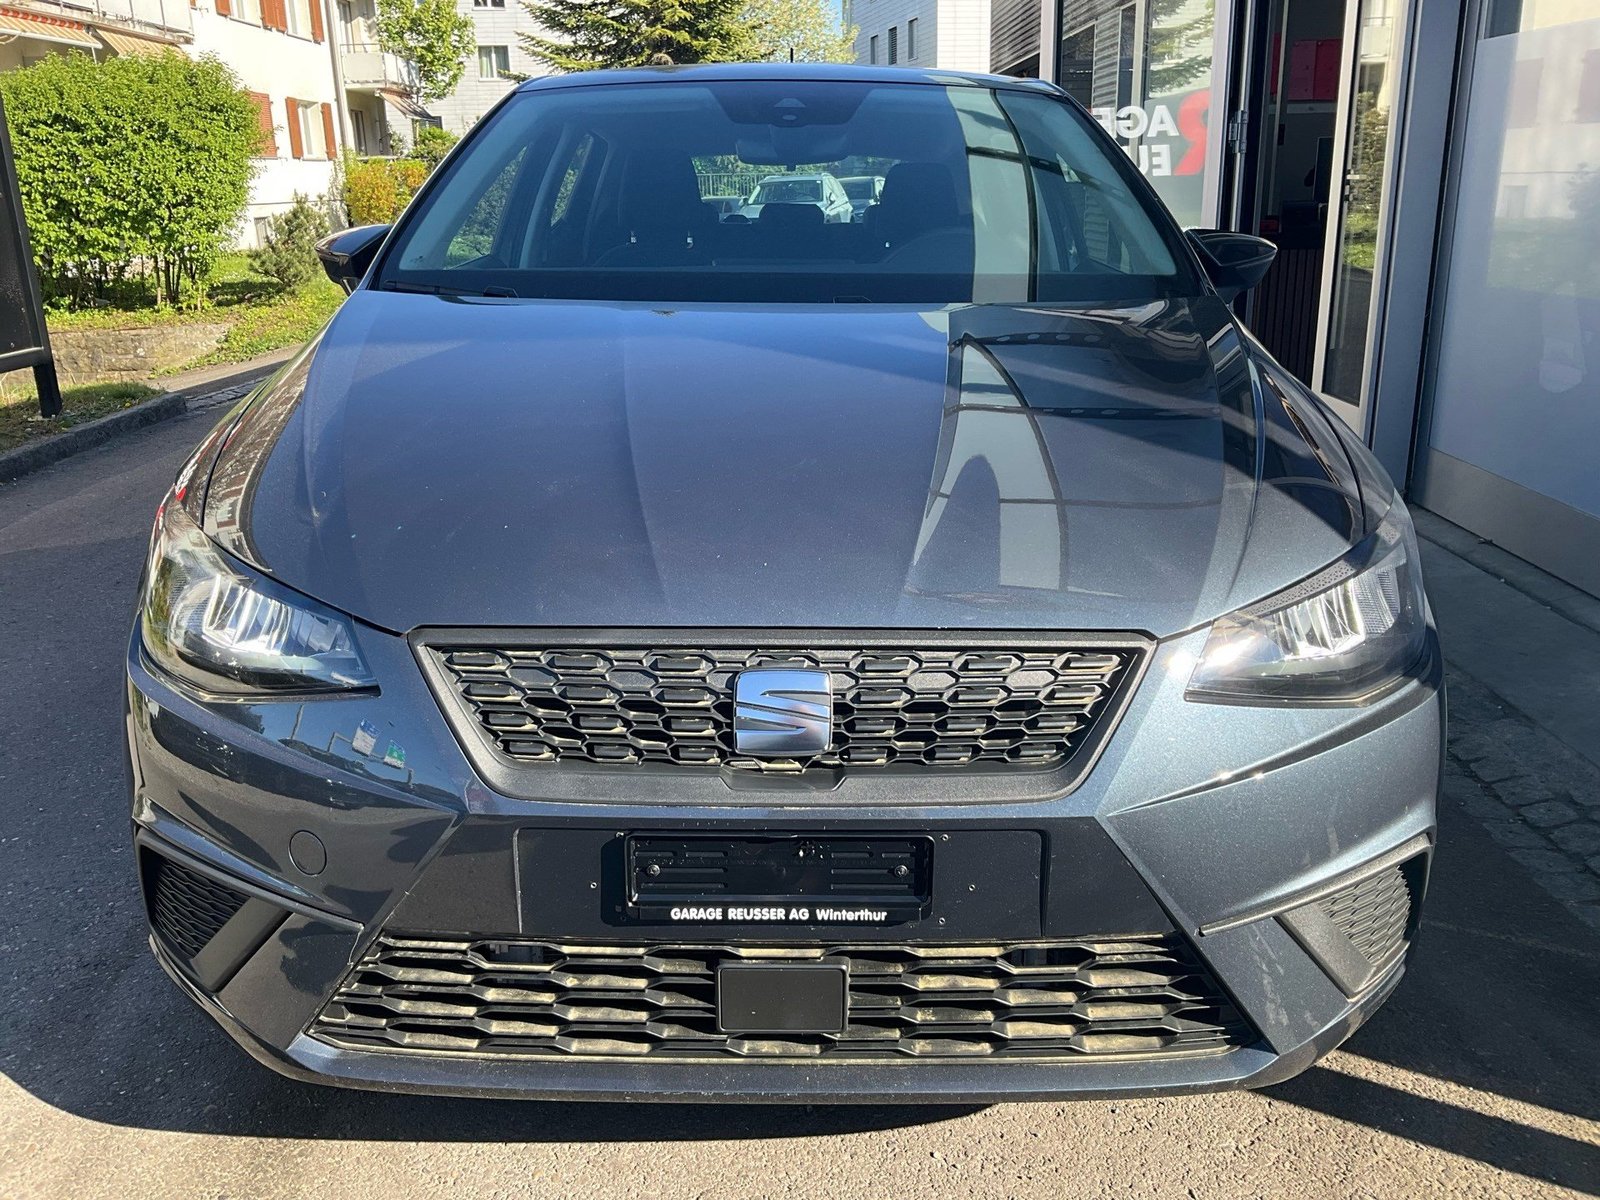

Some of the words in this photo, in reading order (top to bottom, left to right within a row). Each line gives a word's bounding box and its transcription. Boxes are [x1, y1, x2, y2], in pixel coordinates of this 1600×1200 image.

[670, 907, 723, 920] GARAGE
[727, 907, 786, 920] REUSSER
[788, 908, 810, 920] AG
[815, 908, 888, 921] Winterthur
